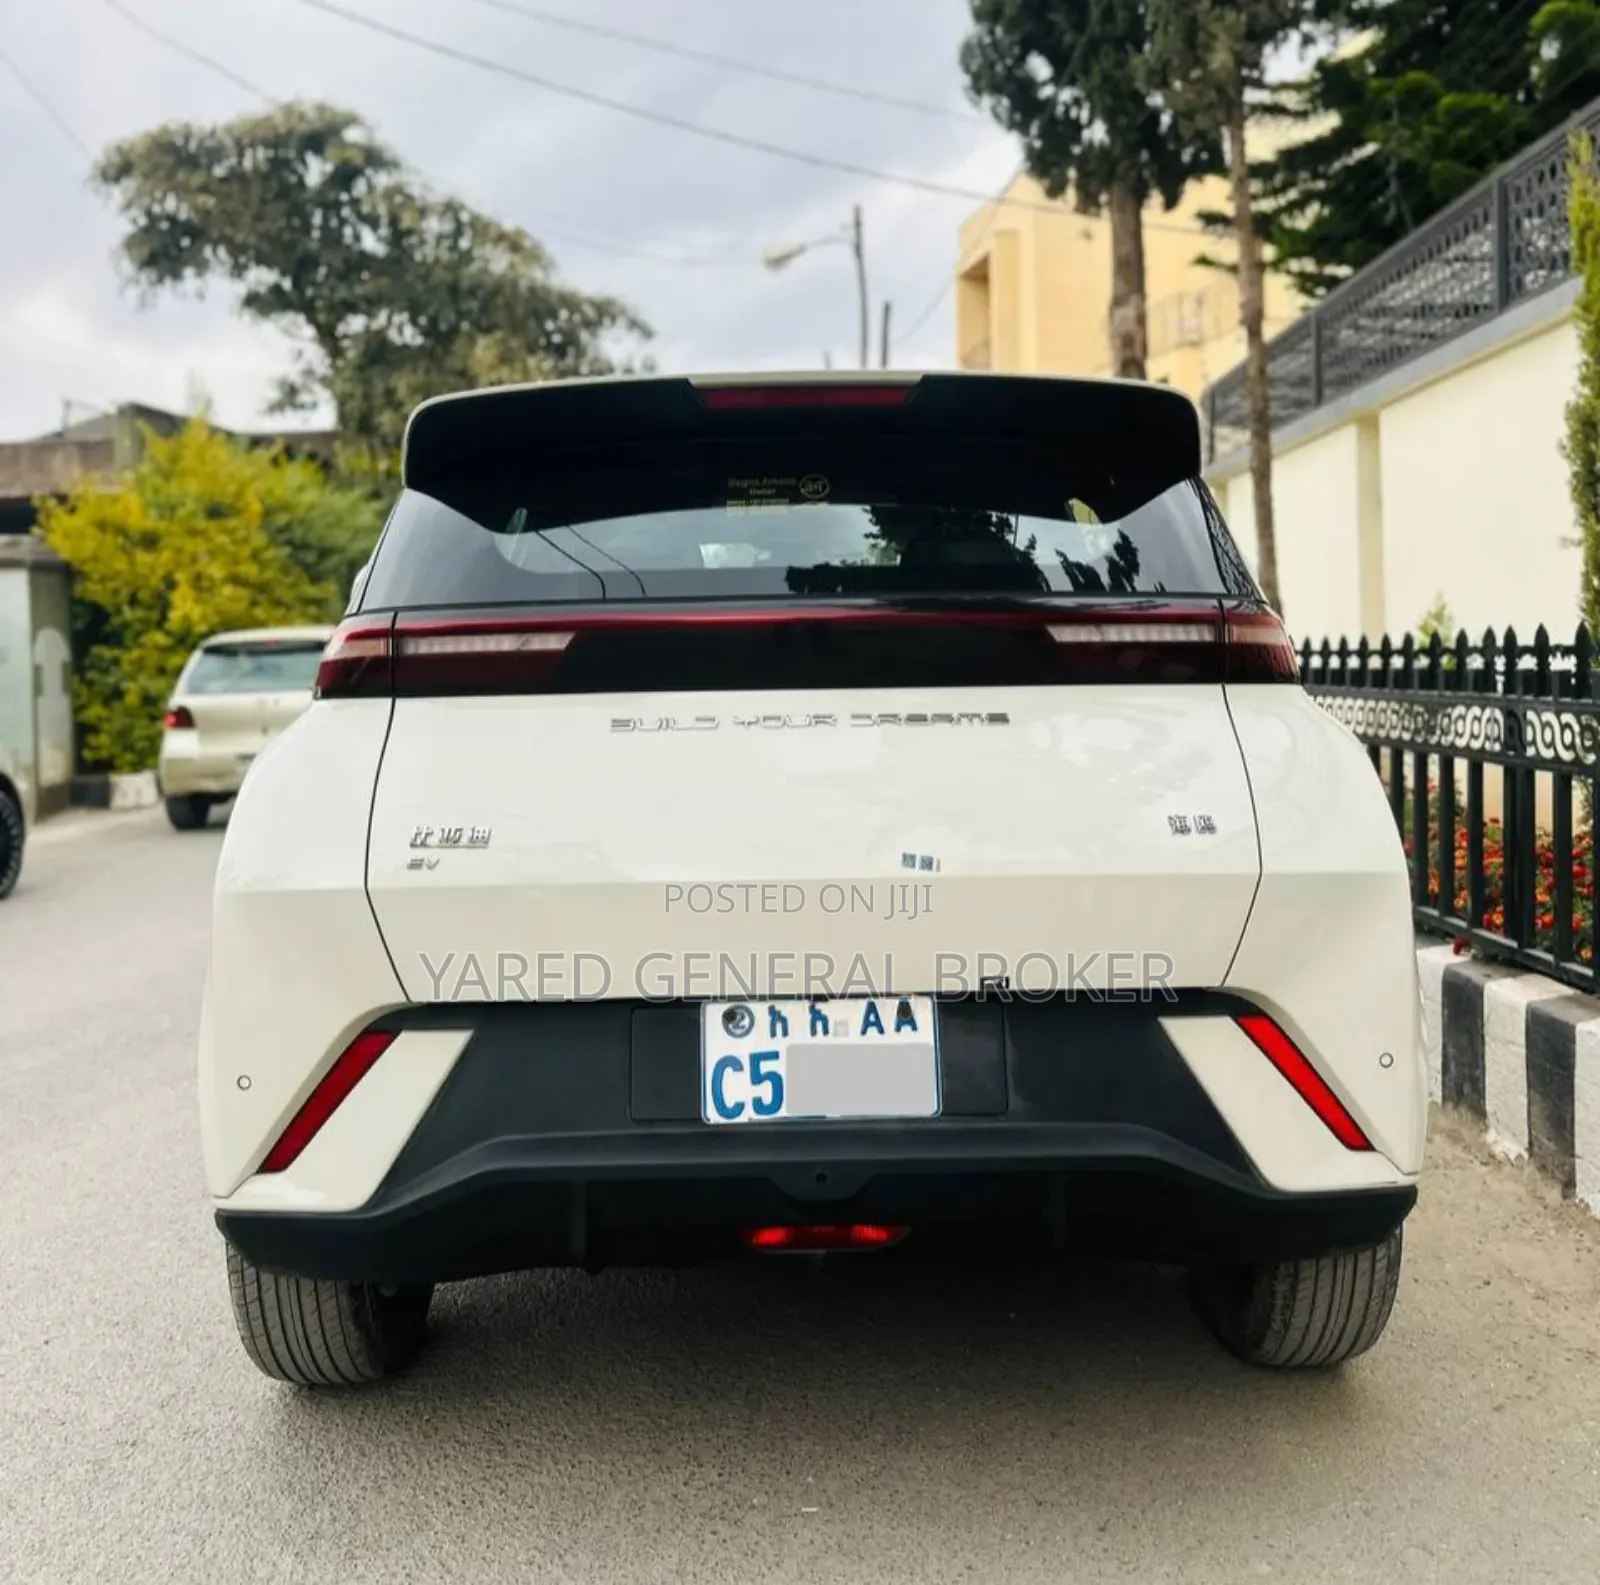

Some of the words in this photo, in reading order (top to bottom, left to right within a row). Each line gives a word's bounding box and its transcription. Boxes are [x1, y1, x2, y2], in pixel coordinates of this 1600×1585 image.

[733, 713, 838, 729] YOUR
[850, 711, 1010, 728] DREAMS
[406, 858, 441, 870] EV
